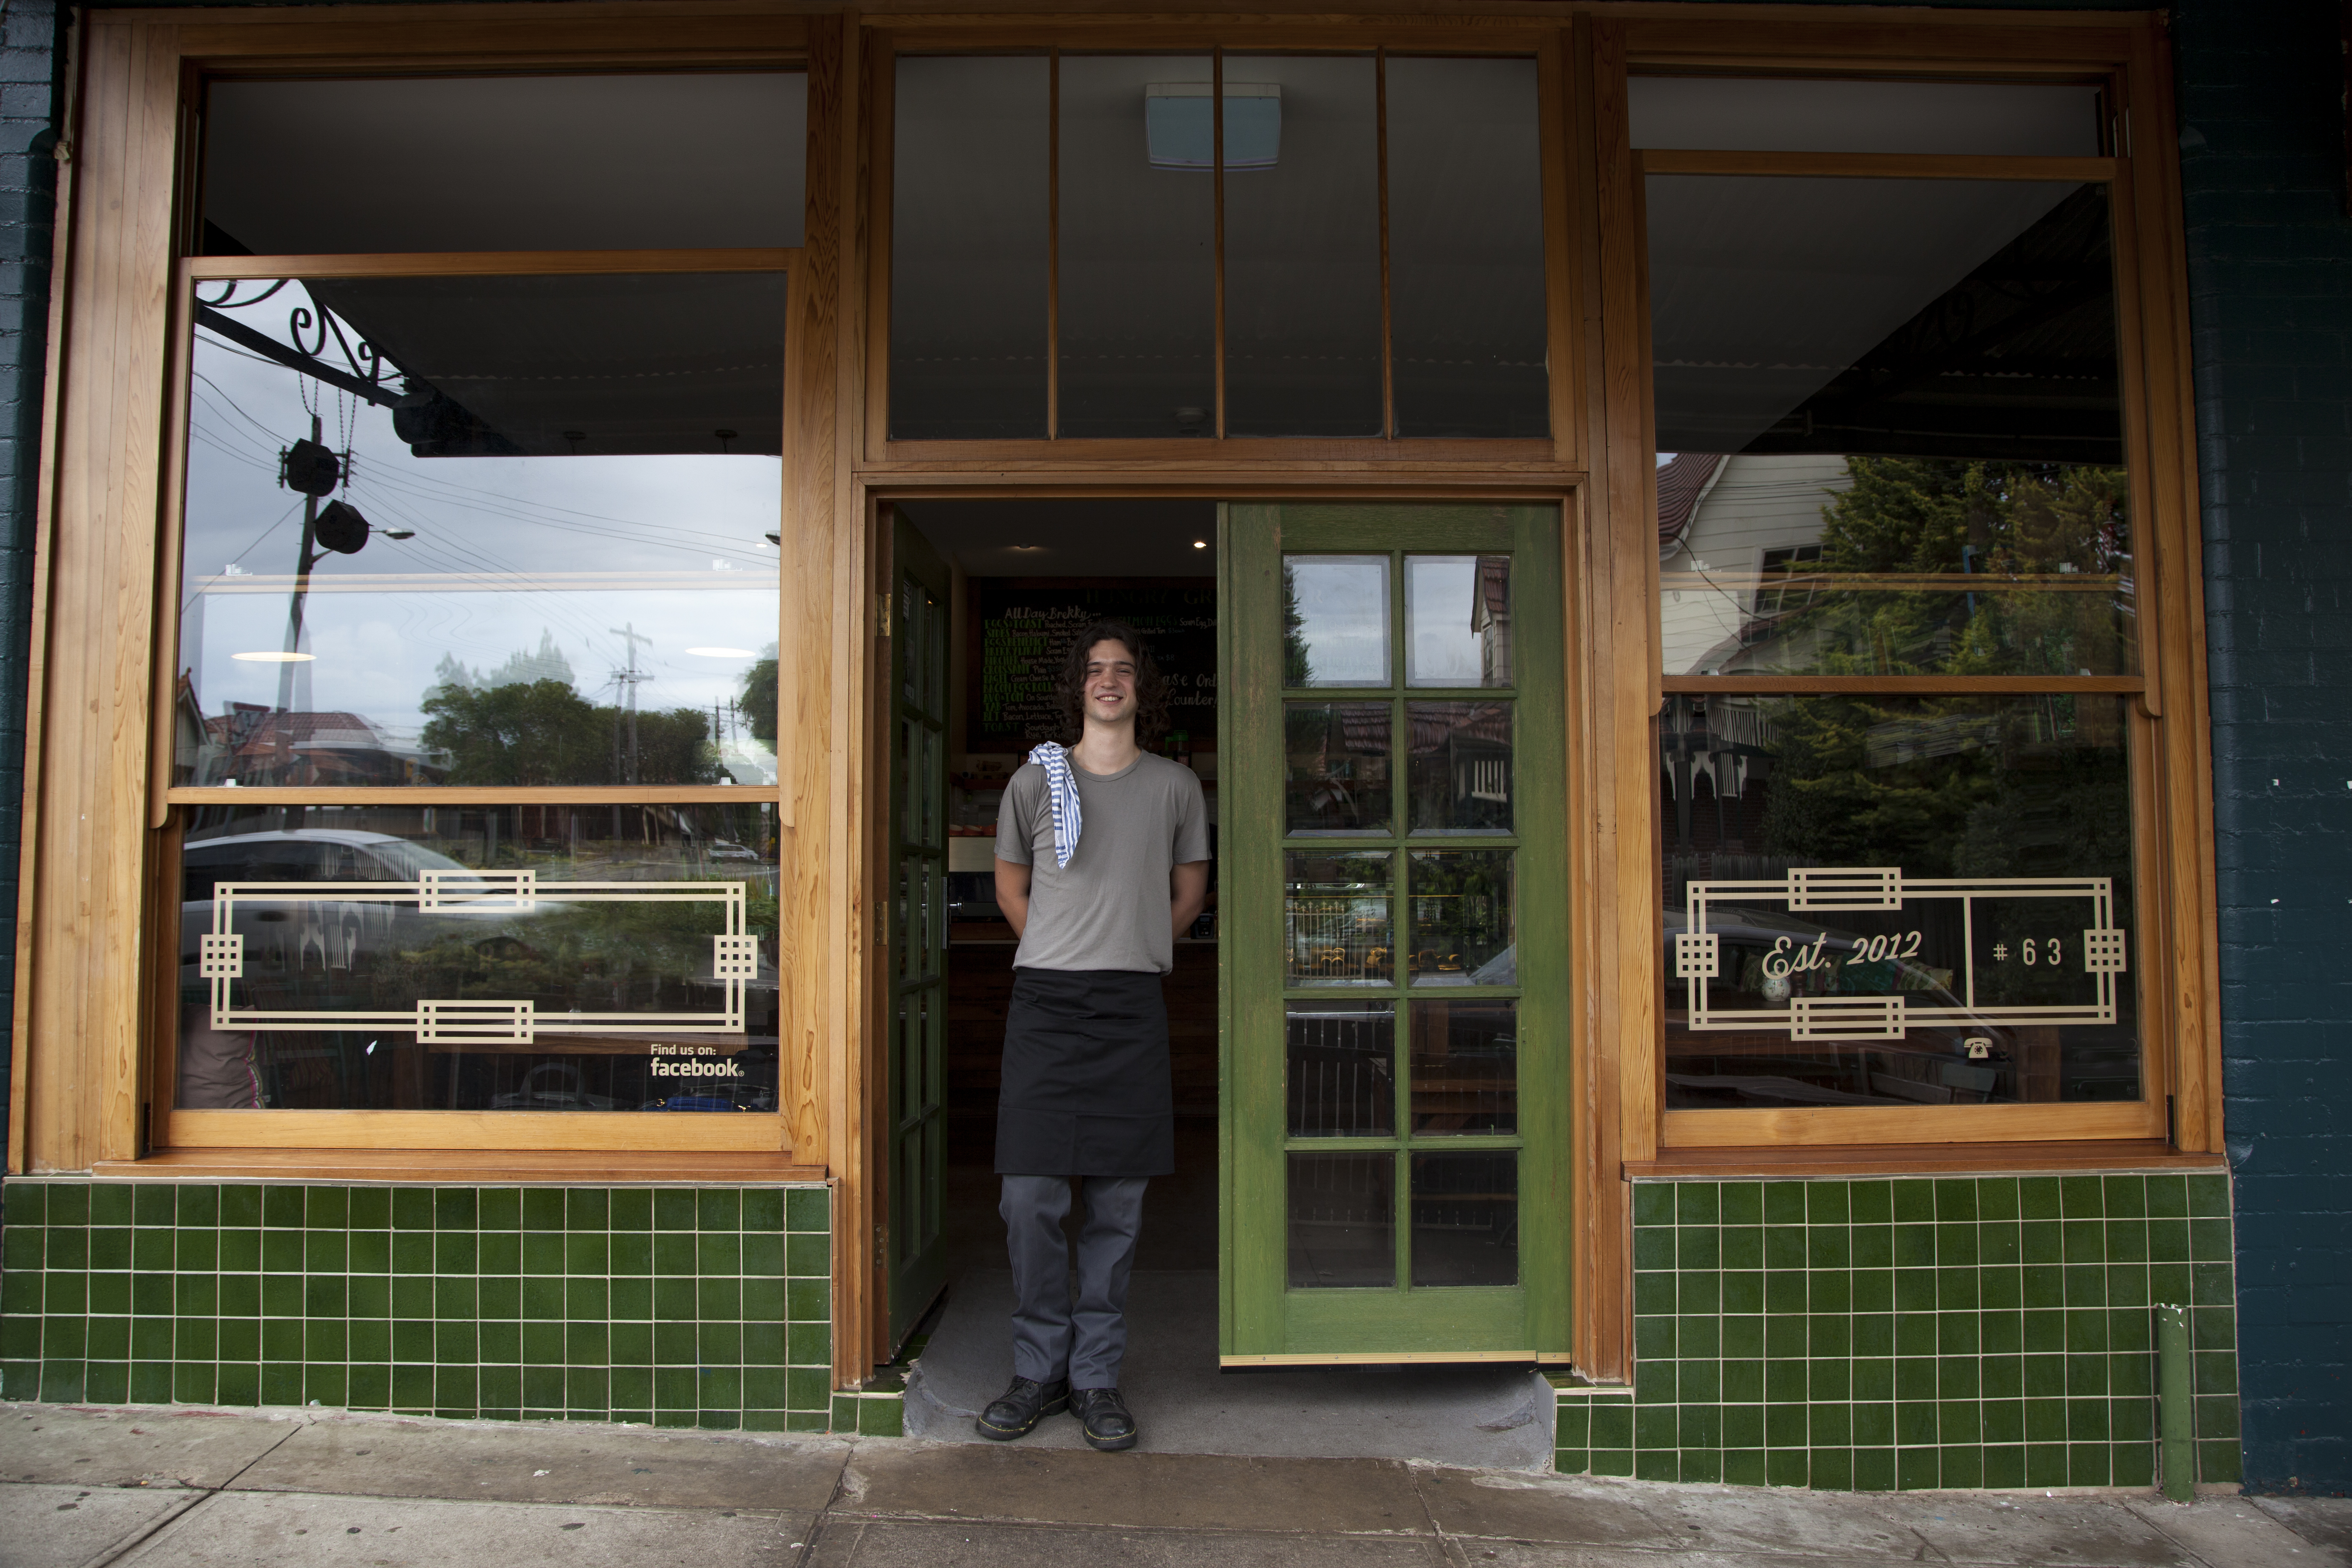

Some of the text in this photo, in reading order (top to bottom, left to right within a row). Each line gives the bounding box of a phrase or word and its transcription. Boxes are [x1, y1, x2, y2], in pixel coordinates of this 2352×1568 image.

[1184, 589, 1217, 605] GR
[1005, 607, 1022, 619] All
[1022, 607, 1049, 621] Day
[985, 628, 1011, 638] SIDES
[1020, 656, 1037, 665] House
[1032, 665, 1047, 674] Plain
[982, 722, 1020, 732] TOAST
[1762, 931, 1922, 980] Est. 2012
[651, 1044, 716, 1055] Find us on:
